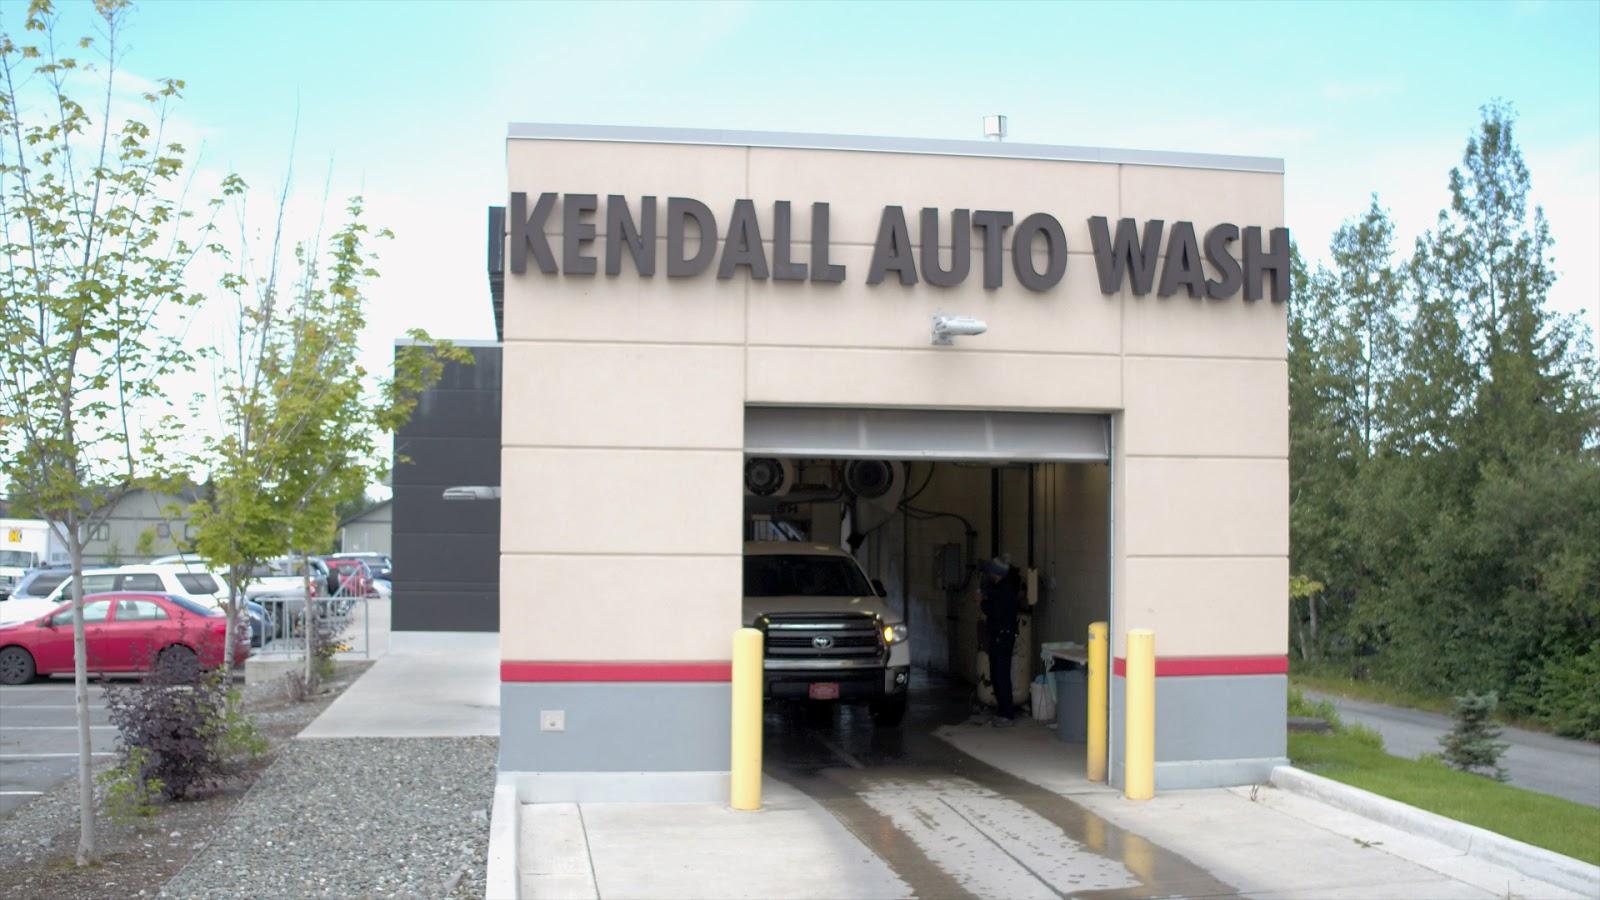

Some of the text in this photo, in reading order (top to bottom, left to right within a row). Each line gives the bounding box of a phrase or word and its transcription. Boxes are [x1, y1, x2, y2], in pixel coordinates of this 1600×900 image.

[510, 191, 1290, 303] KENDALL AUTO WASH
